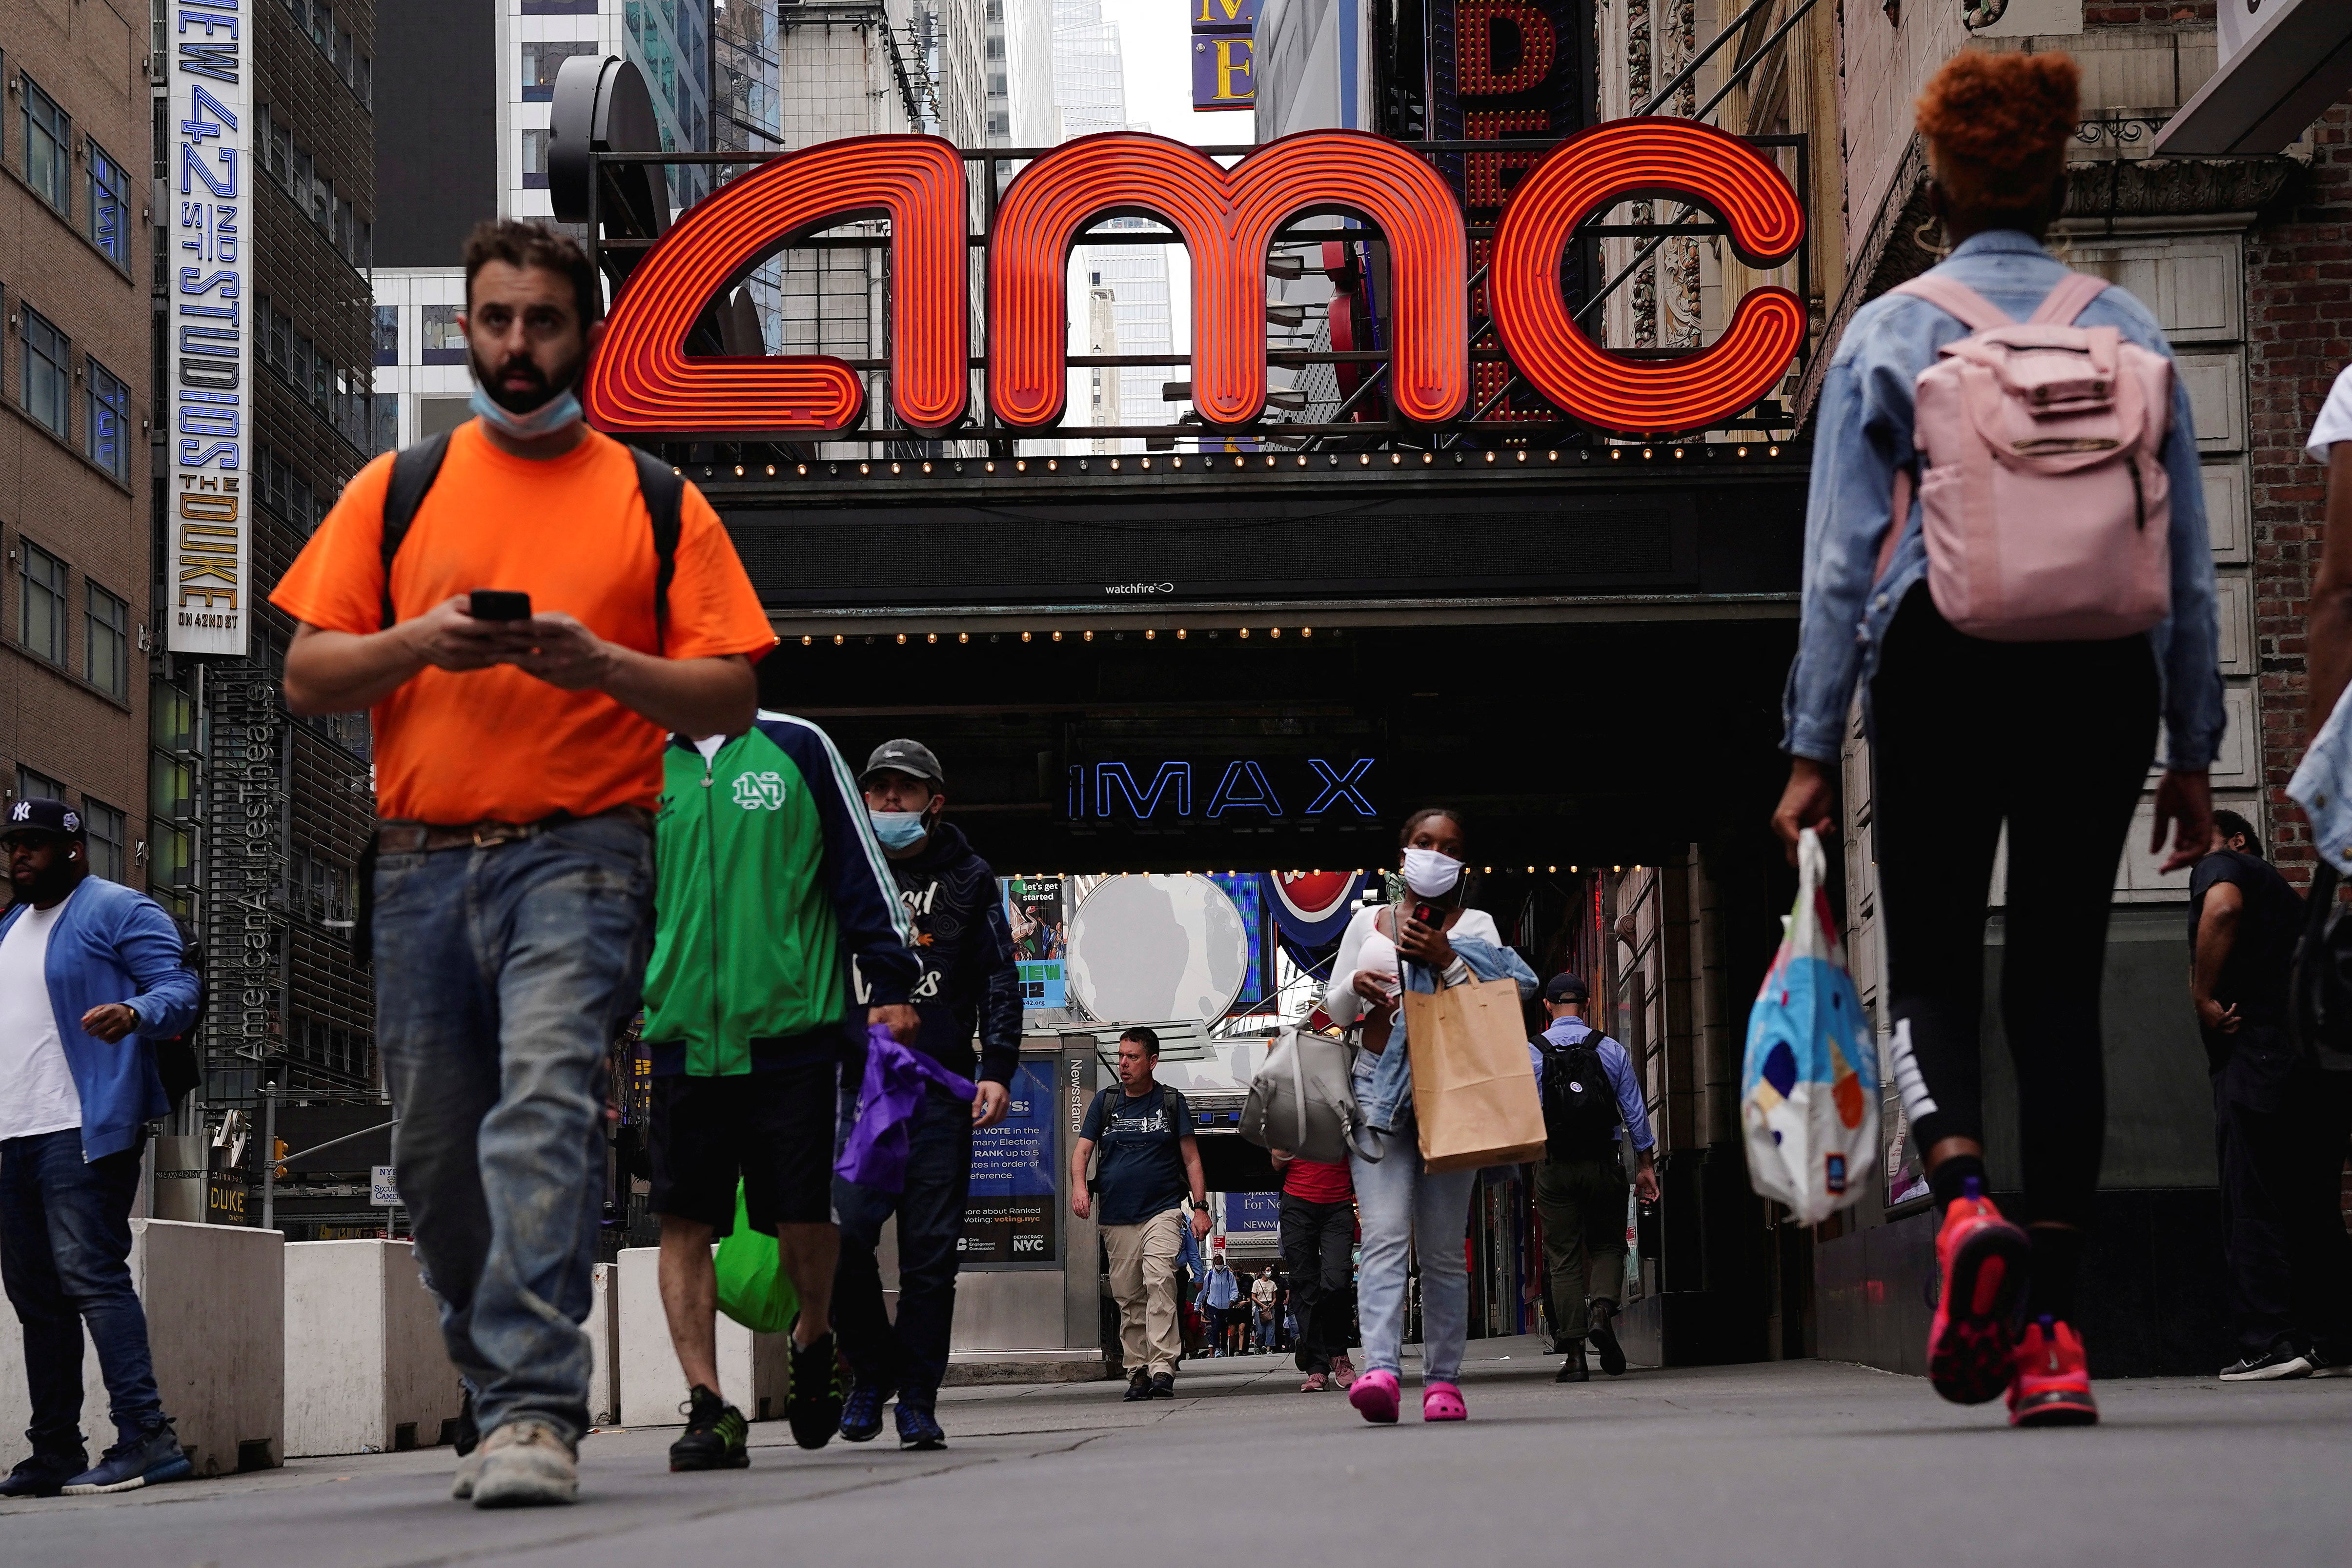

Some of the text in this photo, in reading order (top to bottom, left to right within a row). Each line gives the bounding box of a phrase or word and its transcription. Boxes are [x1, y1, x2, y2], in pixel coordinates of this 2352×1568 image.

[179, 0, 239, 84] EW
[583, 116, 1806, 440] amc
[179, 266, 239, 469] STUDIOS
[179, 474, 239, 610] THE DUKE
[1106, 583, 1155, 594] watchfire
[178, 612, 238, 629] ON 42ND ST
[1069, 758, 1377, 820] IMAX
[13, 801, 31, 821] NY
[1023, 893, 1054, 901] started
[1044, 883, 1058, 892] get
[1071, 1059, 1083, 1132] Newsstand
[211, 1187, 244, 1213] DUKE
[1244, 1199, 1263, 1209] For
[1014, 1240, 1044, 1251] NYC
